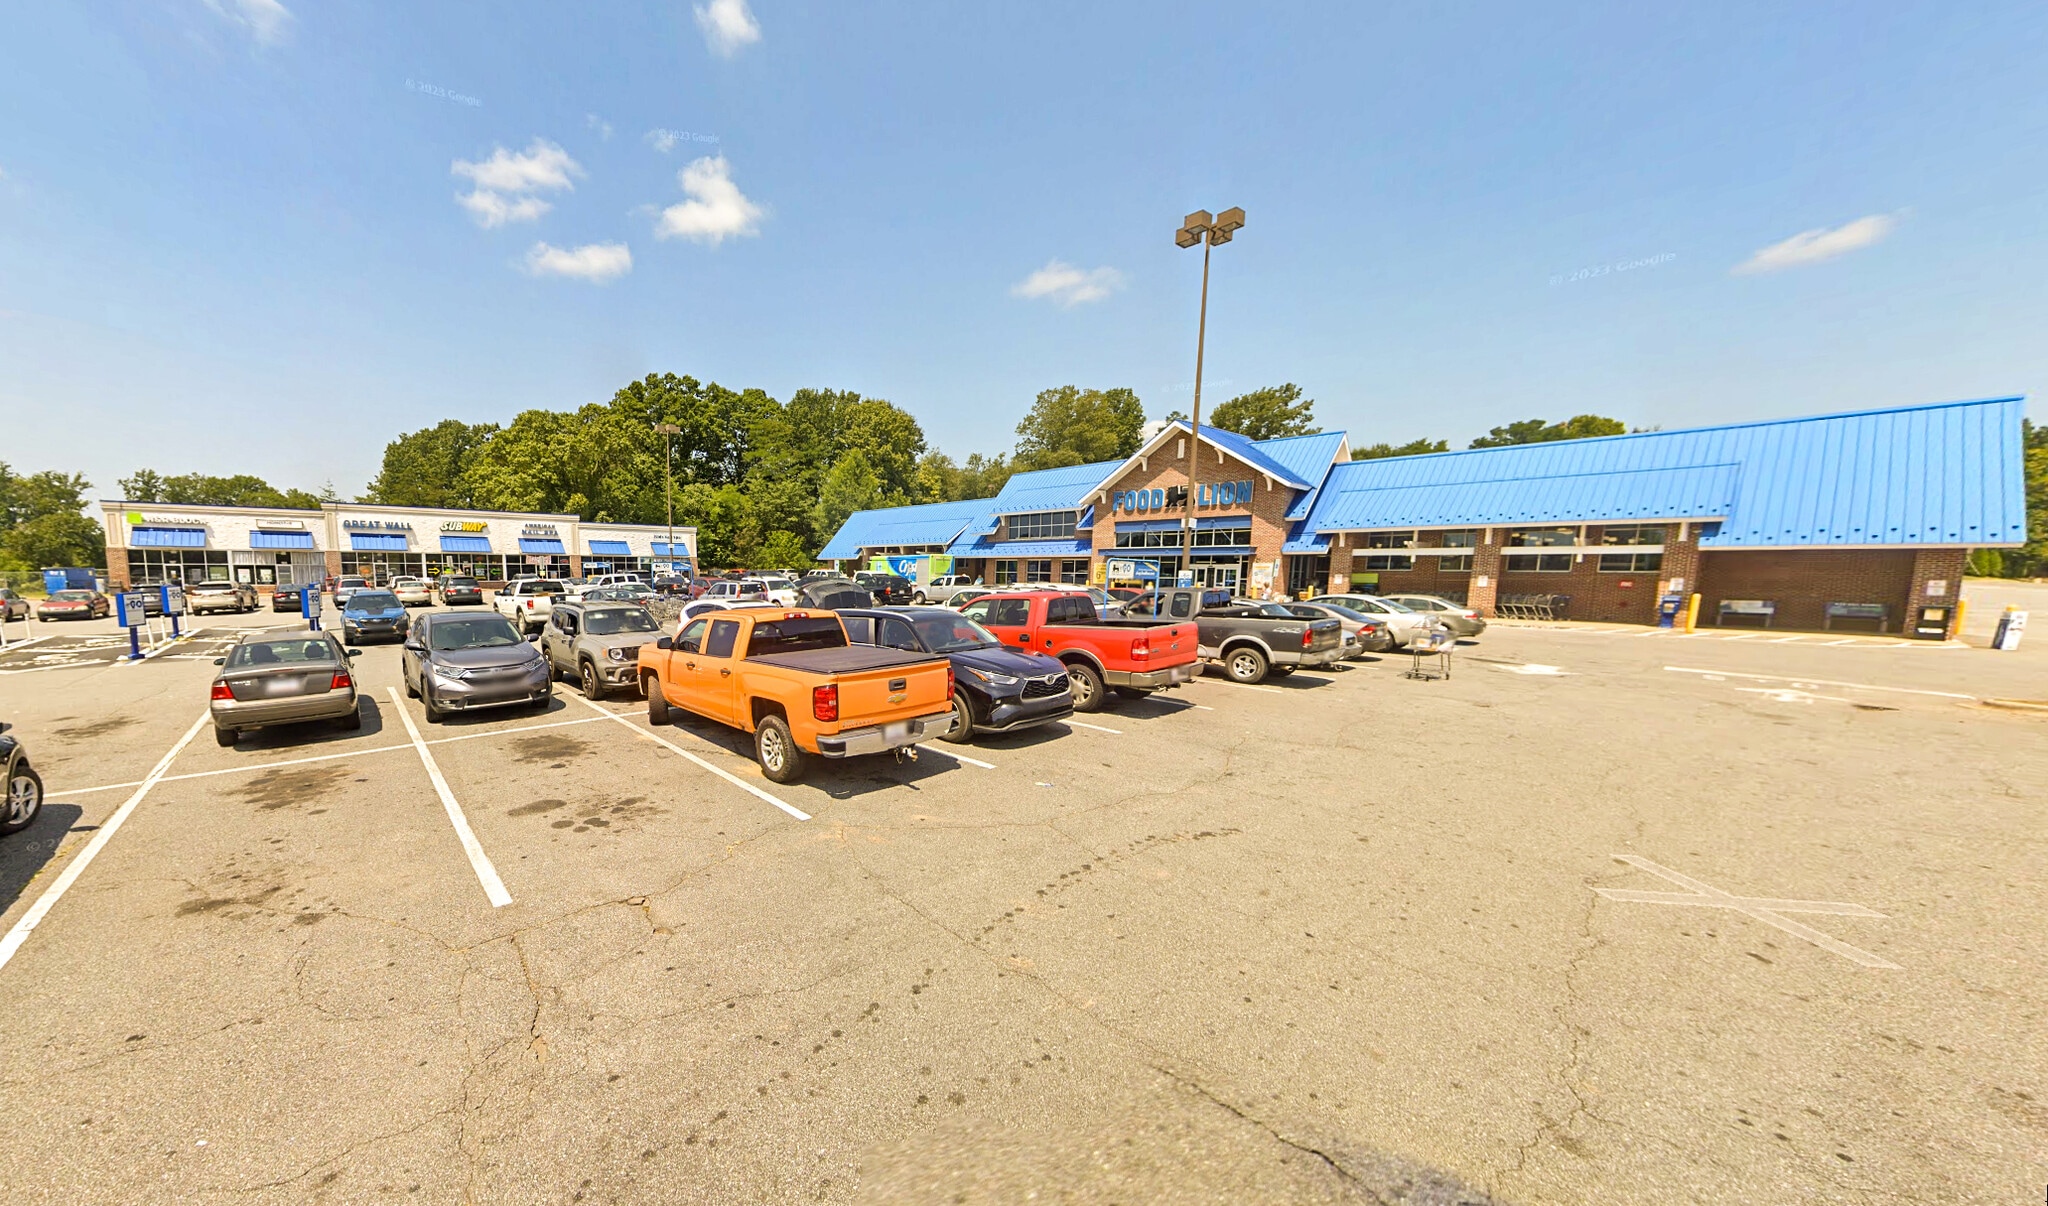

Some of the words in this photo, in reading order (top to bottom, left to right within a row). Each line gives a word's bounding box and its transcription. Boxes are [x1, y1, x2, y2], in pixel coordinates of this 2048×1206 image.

[1112, 488, 1165, 512] FOOD
[1197, 480, 1254, 506] LION
[343, 520, 380, 529] GREAT
[384, 521, 413, 530] WALL
[440, 521, 487, 532] SUBWAY
